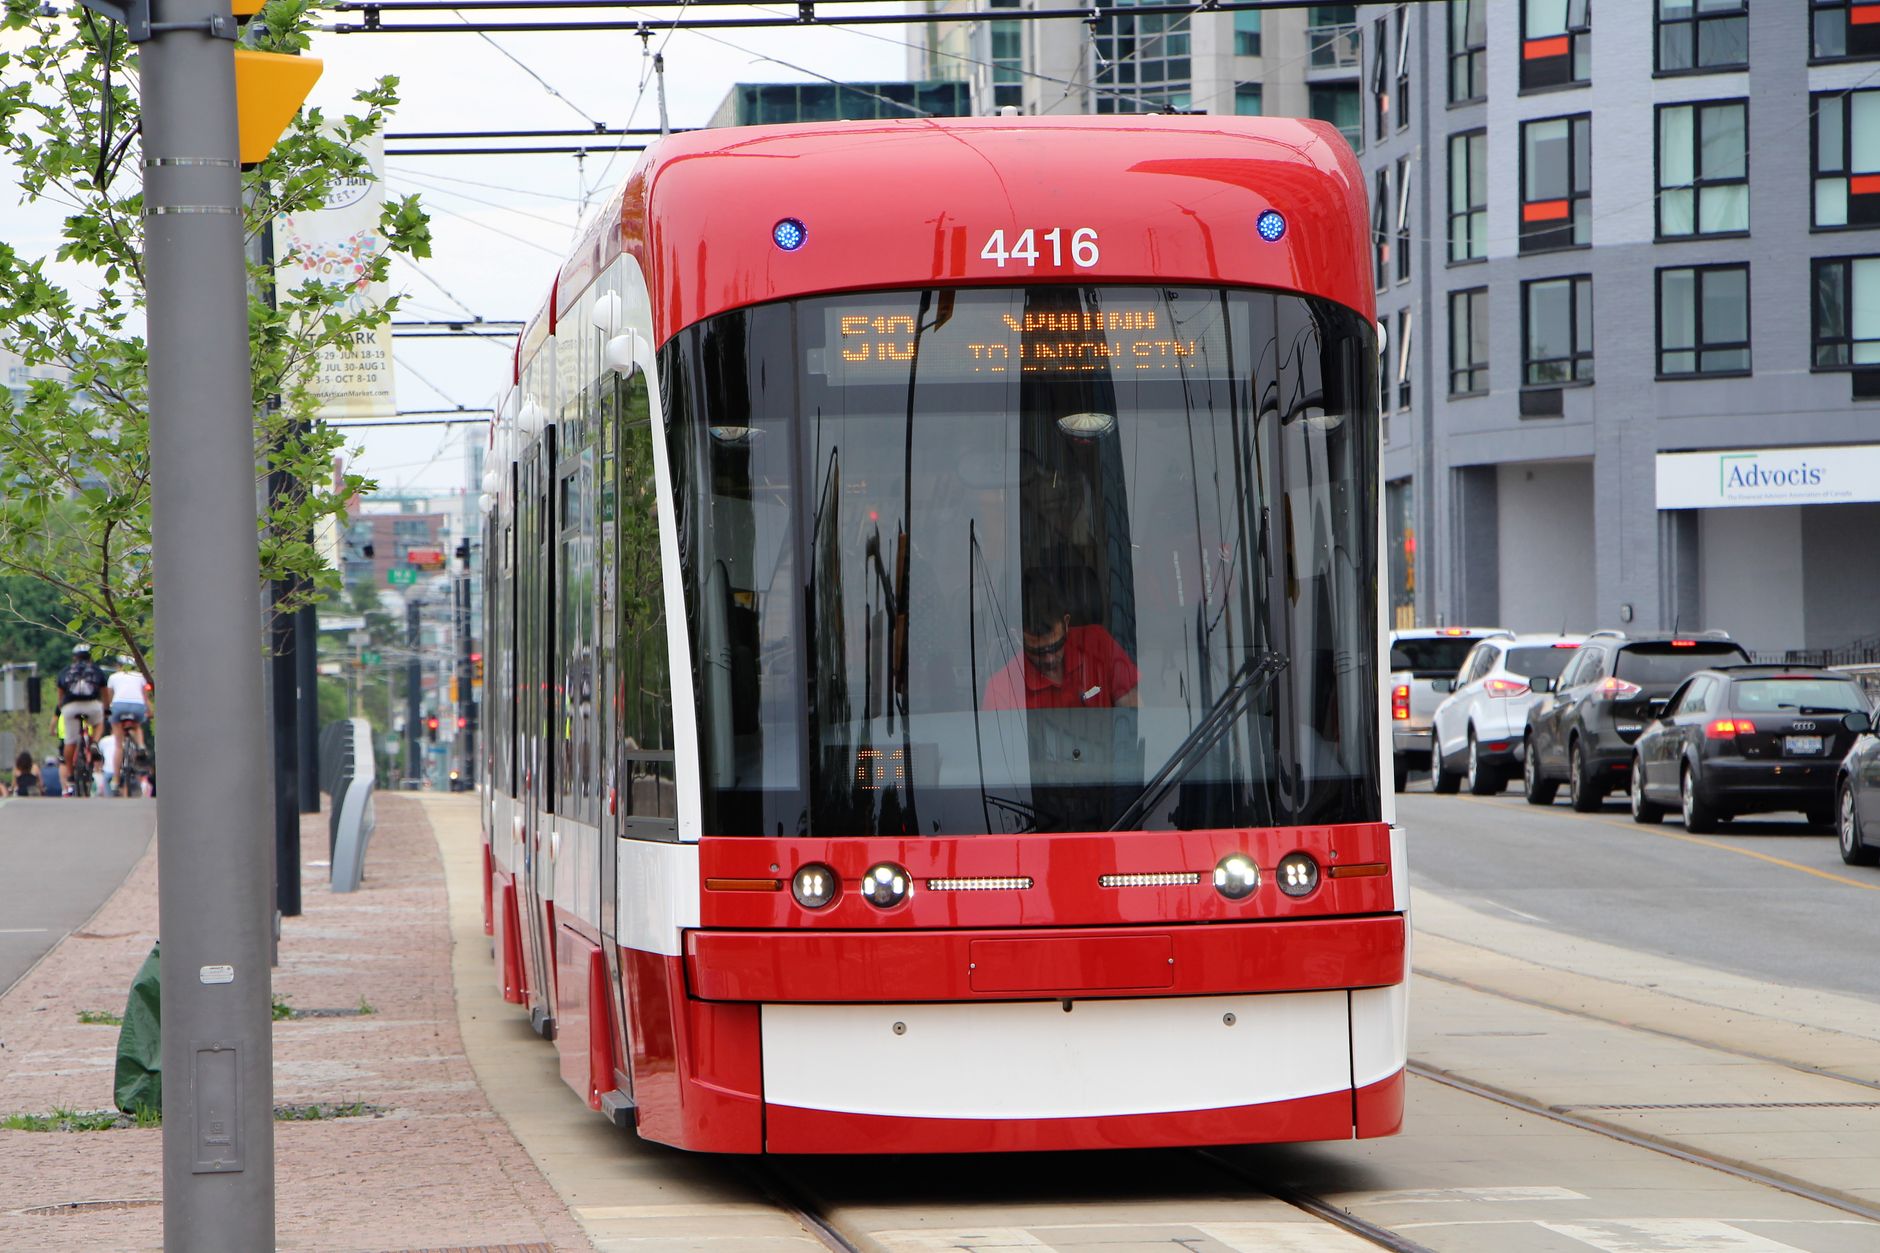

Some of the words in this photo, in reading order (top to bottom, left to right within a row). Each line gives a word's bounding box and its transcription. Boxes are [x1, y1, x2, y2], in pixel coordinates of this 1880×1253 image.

[980, 227, 1099, 268] 4416
[842, 316, 915, 361] 510
[1728, 461, 1822, 489] Advocis
